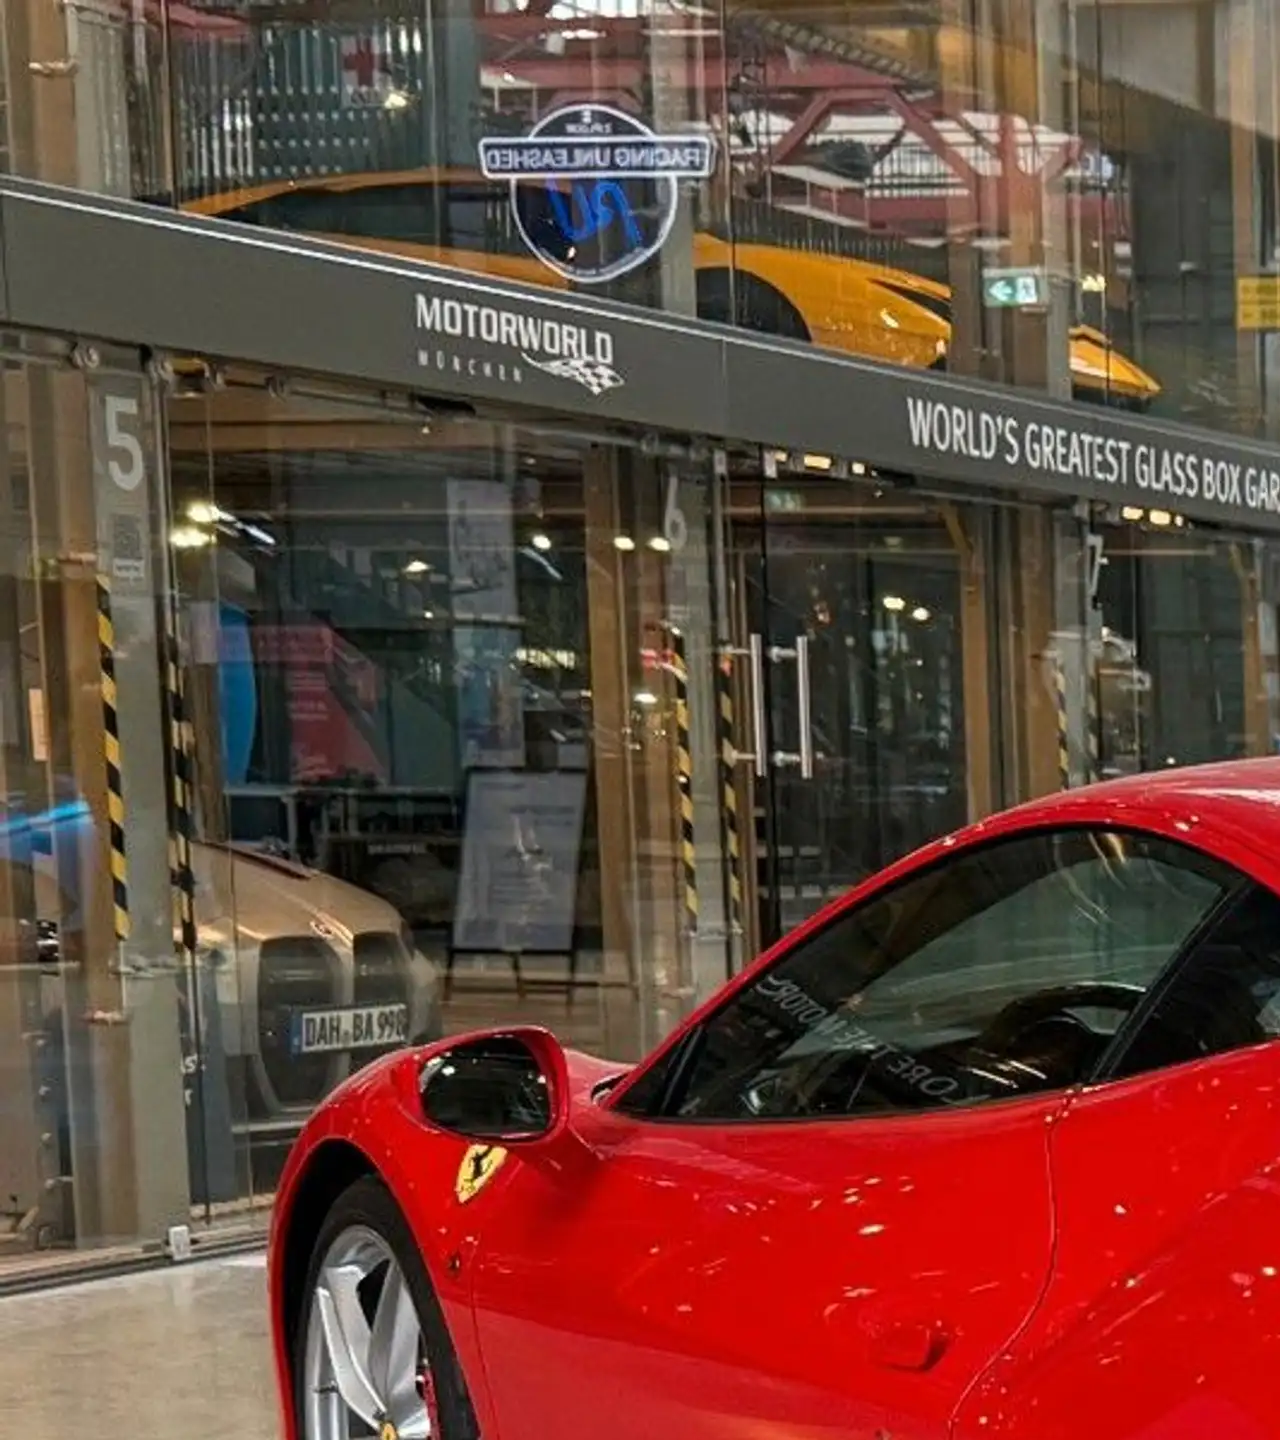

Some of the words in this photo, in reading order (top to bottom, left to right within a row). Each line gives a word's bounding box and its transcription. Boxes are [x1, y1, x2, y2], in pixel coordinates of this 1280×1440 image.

[415, 293, 613, 366] MOTORWORLD
[105, 395, 144, 491] 5
[907, 397, 1018, 464] WORLD'S
[1025, 422, 1133, 484] GREATEST
[1134, 444, 1199, 499] GLASS
[1202, 457, 1242, 501] BOX
[304, 1014, 341, 1047] DAH
[352, 1011, 374, 1042] BA
